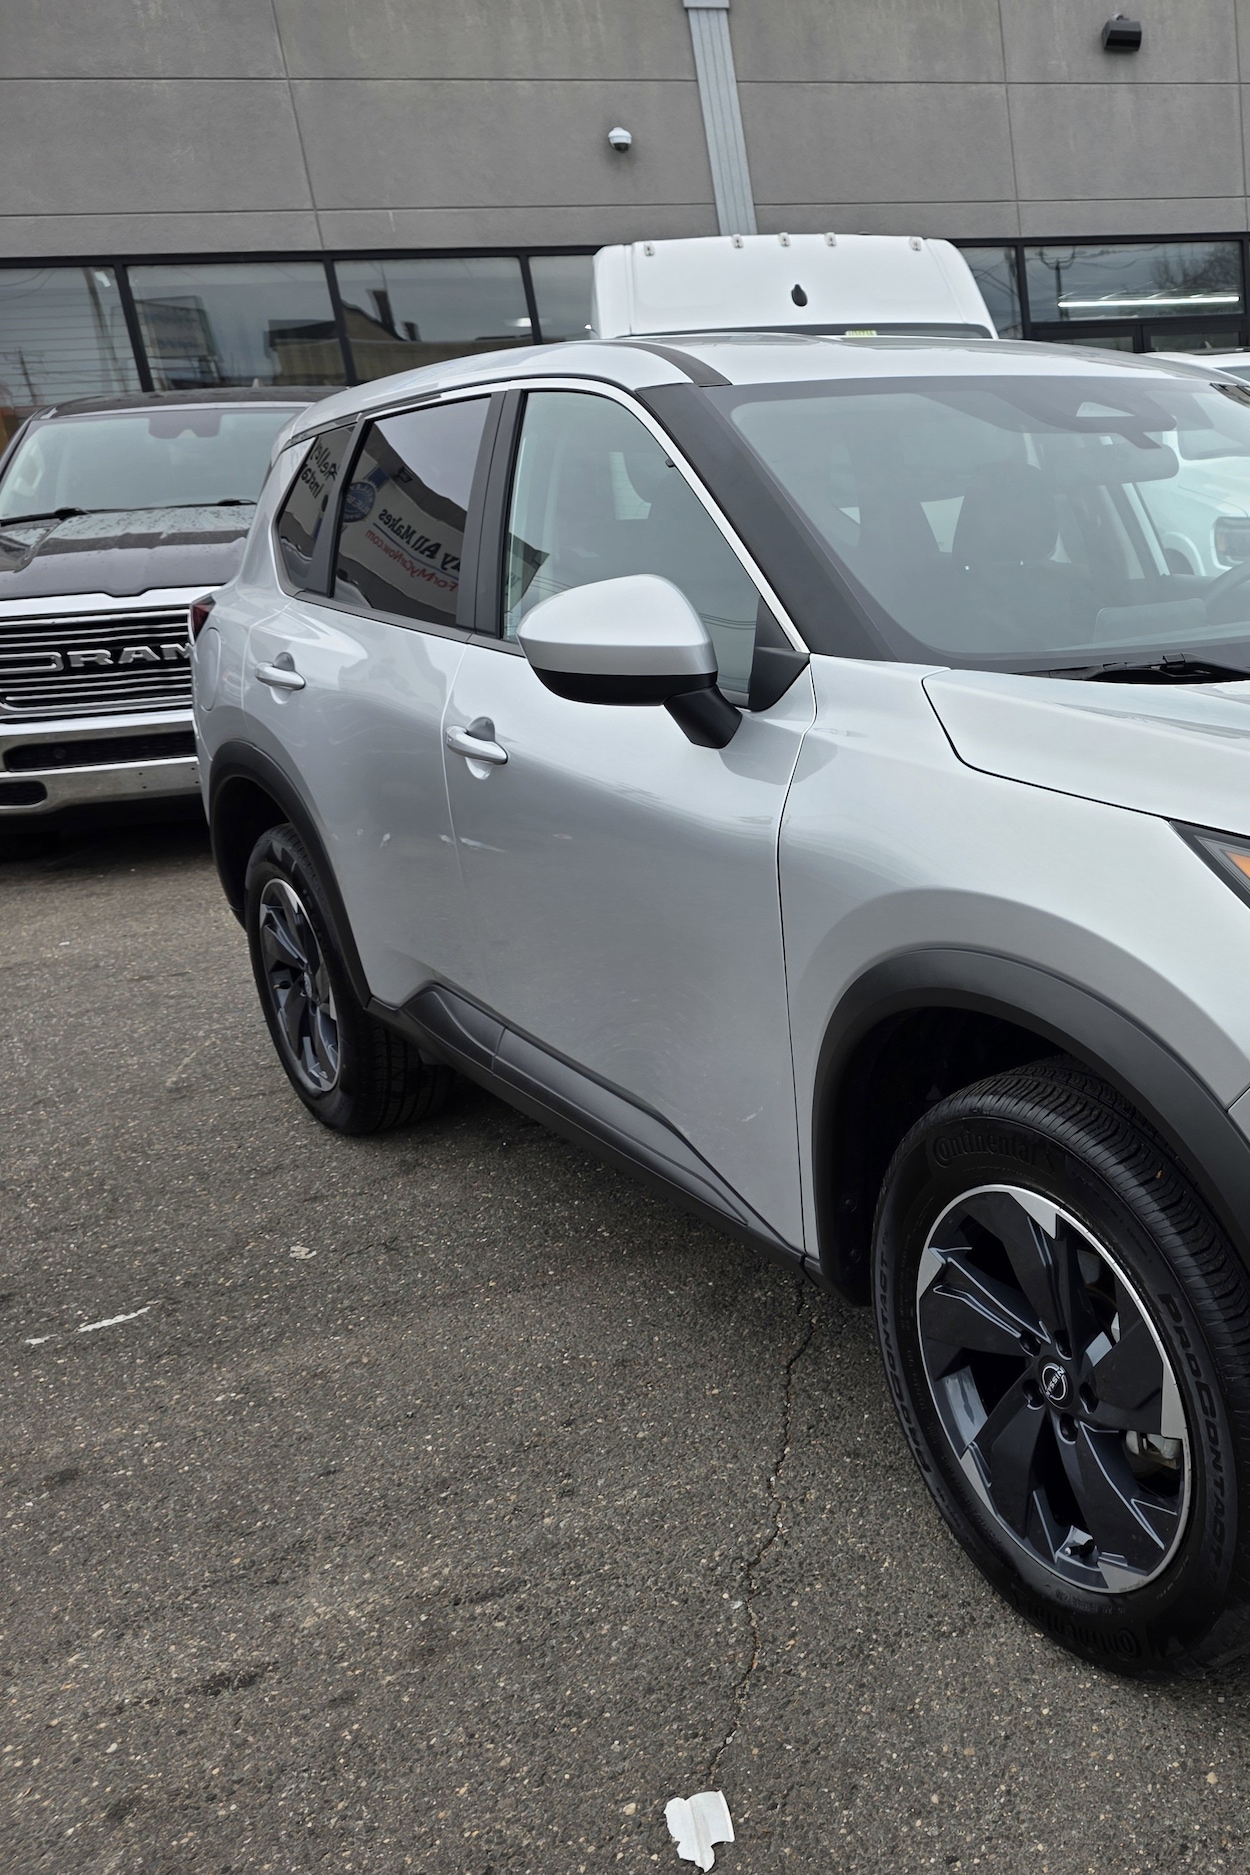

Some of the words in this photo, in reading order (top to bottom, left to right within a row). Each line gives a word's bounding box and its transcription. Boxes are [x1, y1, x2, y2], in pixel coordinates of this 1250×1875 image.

[67, 643, 195, 668] RAM
[933, 1138, 1038, 1179] Continental
[1046, 1365, 1066, 1397] NISSAN
